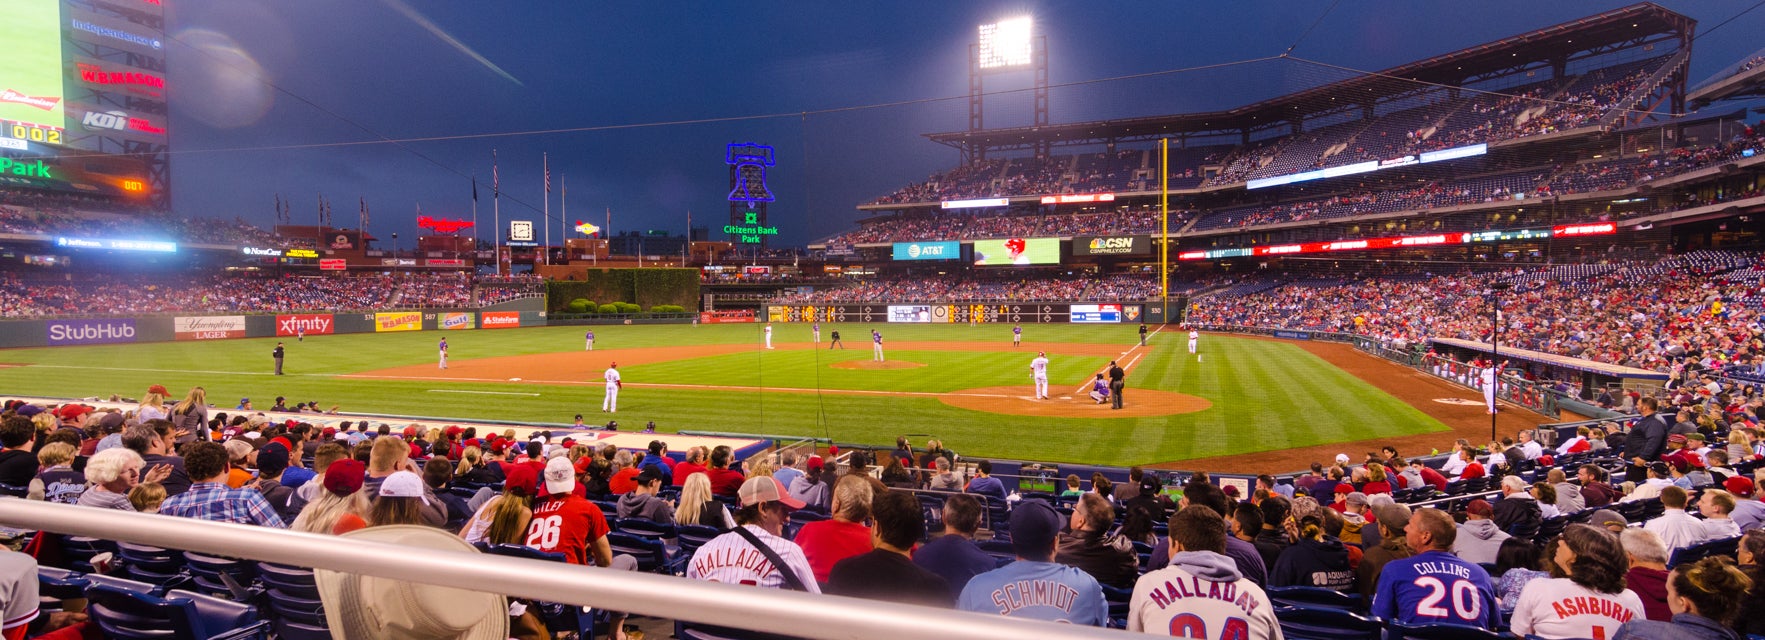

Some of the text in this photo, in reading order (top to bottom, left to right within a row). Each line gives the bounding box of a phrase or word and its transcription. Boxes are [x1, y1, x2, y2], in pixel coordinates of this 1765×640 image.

[72, 19, 149, 46] Independence
[82, 111, 127, 131] KDI
[0, 157, 51, 178] Park
[723, 225, 778, 235] Citizens Bank
[741, 235, 760, 243] Park
[921, 245, 944, 256] AT&T
[1106, 238, 1133, 248] CSN
[184, 317, 236, 331] Yuengling
[281, 316, 330, 334] xfinity
[444, 316, 467, 327] Gulf
[50, 323, 135, 340] StubHub
[196, 331, 227, 339] LAGER
[525, 515, 563, 550] 26
[695, 547, 778, 579] HALLADAY
[1413, 561, 1470, 579] COLLINS
[991, 579, 1079, 616] SCHMIDT
[1149, 576, 1260, 616] HALLADAY
[1413, 575, 1481, 621] 20
[1551, 596, 1634, 624] ASHBURN
